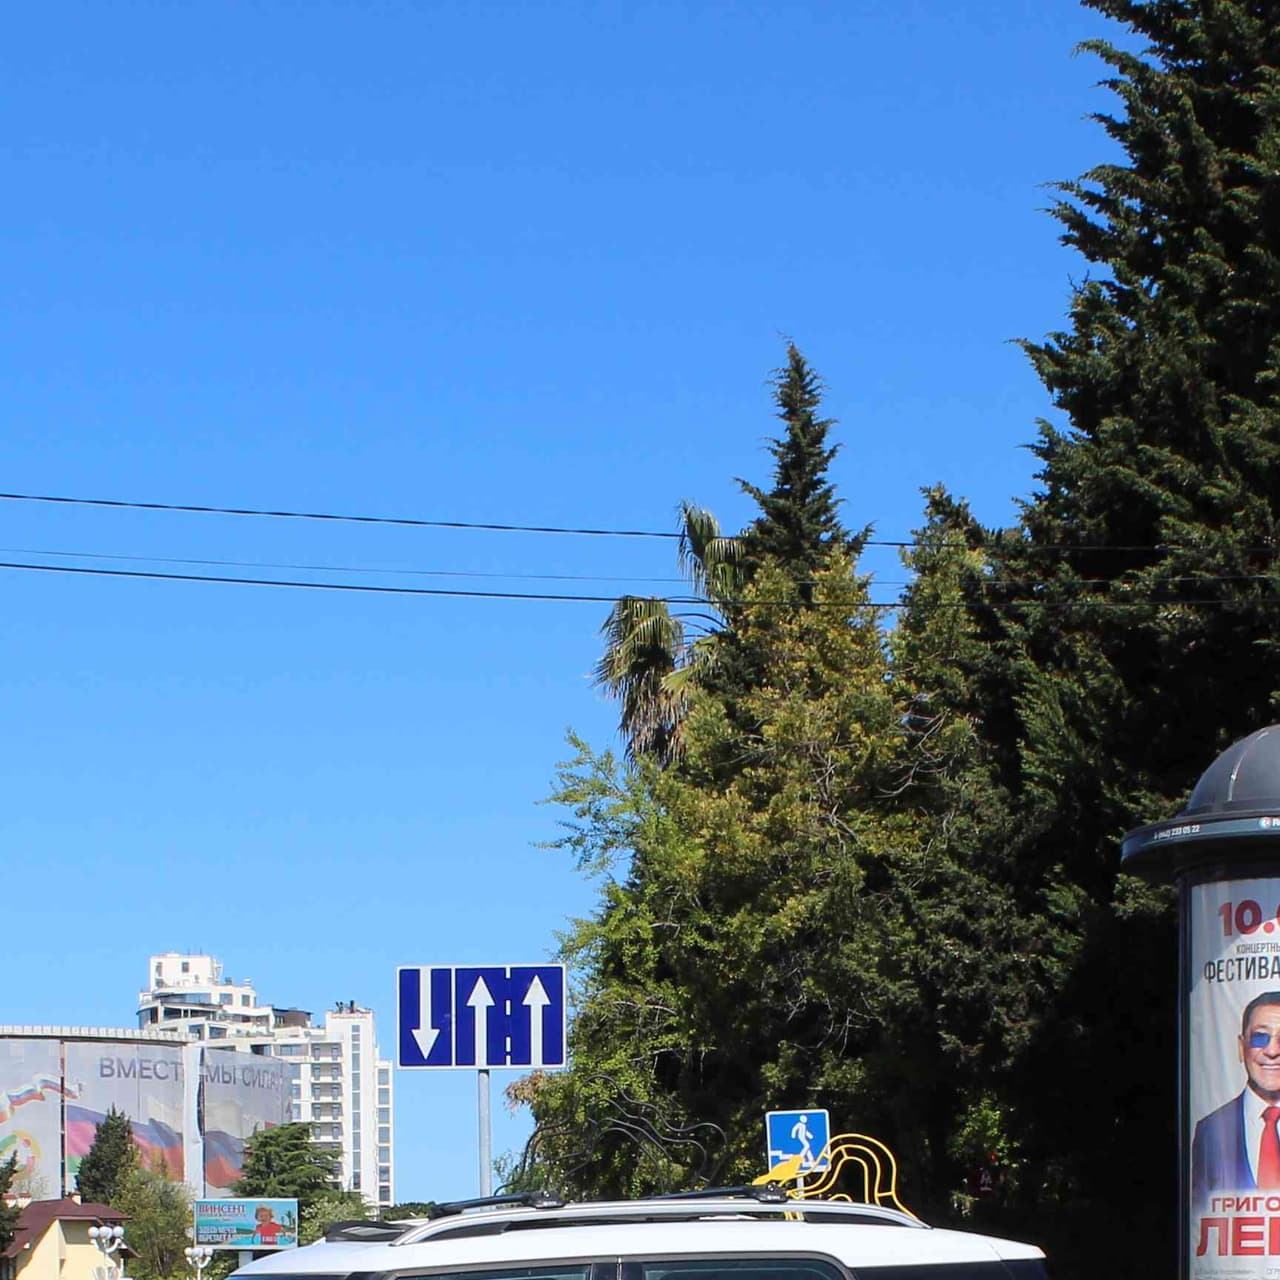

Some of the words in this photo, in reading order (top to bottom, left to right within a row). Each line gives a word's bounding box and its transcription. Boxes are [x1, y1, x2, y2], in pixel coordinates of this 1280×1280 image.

[1191, 824, 1201, 833] 22
[100, 1056, 184, 1083] ВМЕСТ
[205, 1063, 237, 1085] МЫ
